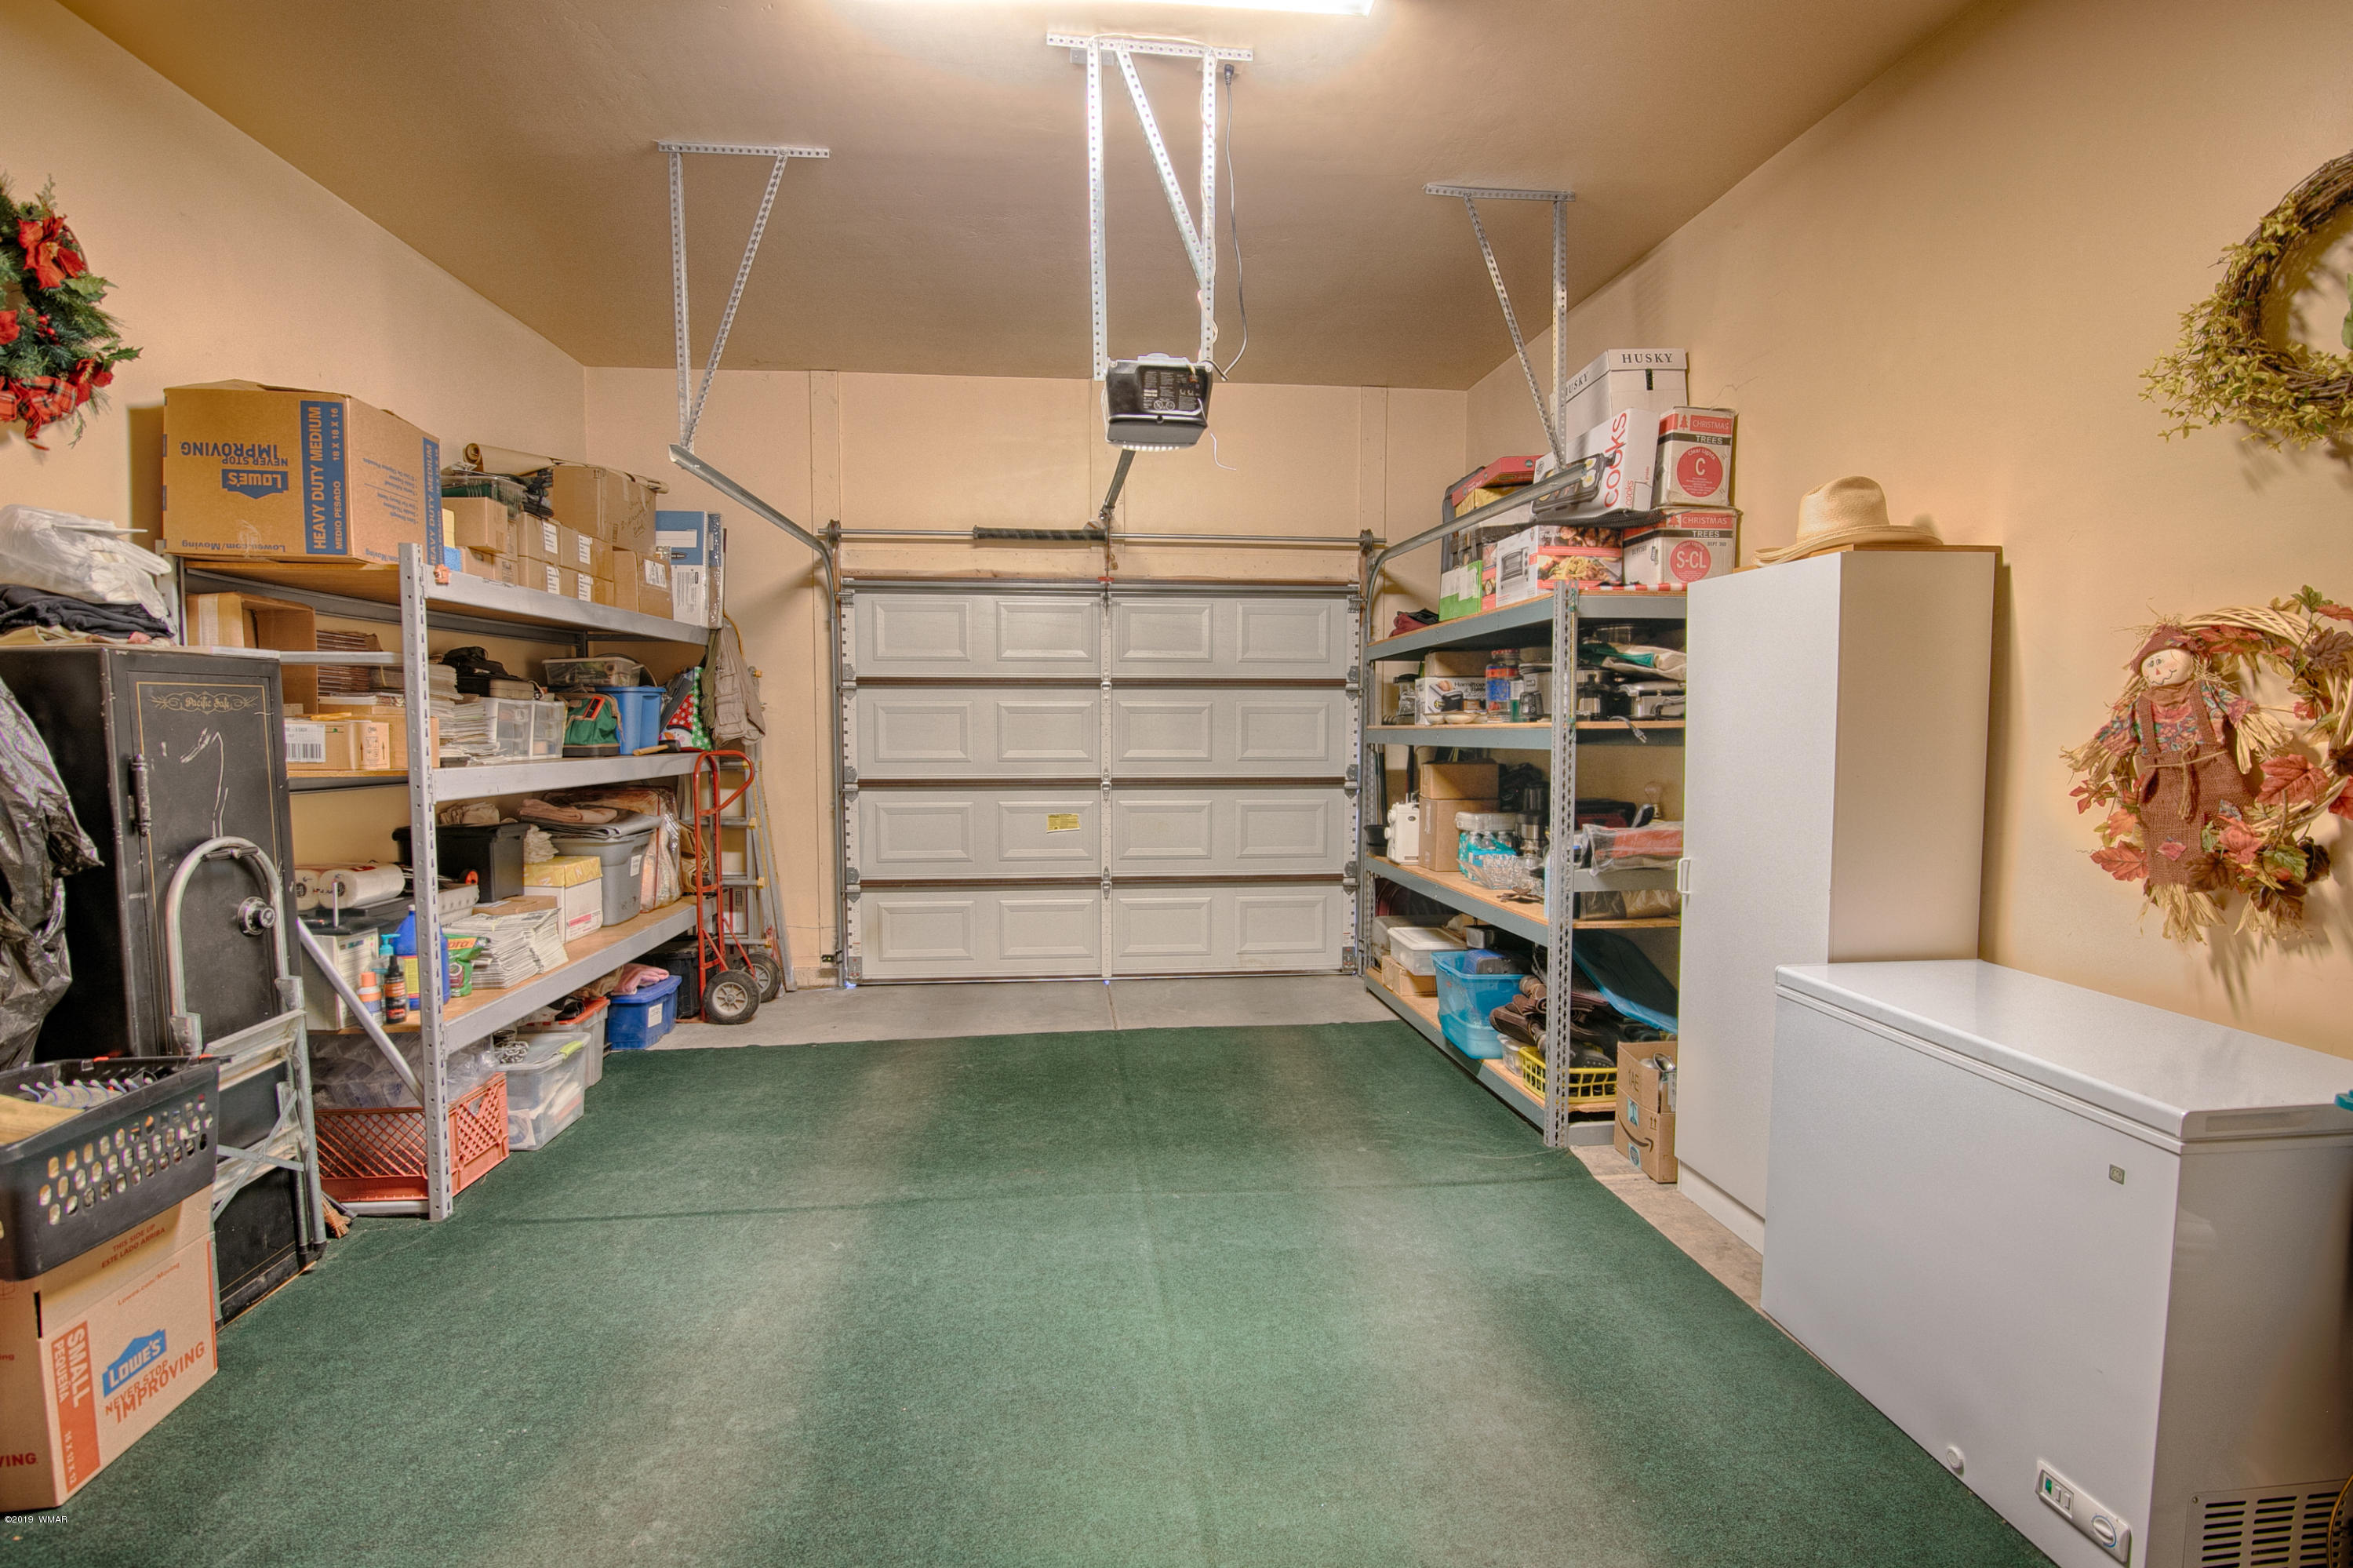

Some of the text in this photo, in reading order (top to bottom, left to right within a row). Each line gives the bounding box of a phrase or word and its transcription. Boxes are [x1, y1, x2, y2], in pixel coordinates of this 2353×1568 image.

[1622, 353, 1673, 363] HUSKY
[1693, 420, 1729, 430] CHRISTMAS
[181, 442, 278, 460] IMPROVING
[1696, 435, 1723, 445] TREES
[222, 457, 288, 466] NEVER STOP
[333, 449, 340, 461] 18
[425, 445, 435, 492] MEDIUM
[1695, 457, 1706, 475] C
[227, 472, 281, 488] LOWE'S
[308, 406, 326, 549] HEAVY DUTY MEDIUM
[333, 480, 344, 549] MEDIO PESADO
[427, 496, 436, 526] DUTY
[1676, 551, 1707, 569] S-CL
[101, 1227, 165, 1268] ESTE LADO ARRIBA
[112, 1224, 156, 1252] THIS SIDE UP
[53, 1338, 71, 1404] PEQUEÑA
[67, 1327, 90, 1408] SMALL
[108, 1337, 162, 1388] LOWE'S
[104, 1359, 169, 1416] NEVER STOP
[117, 1341, 205, 1424] IMPROVING
